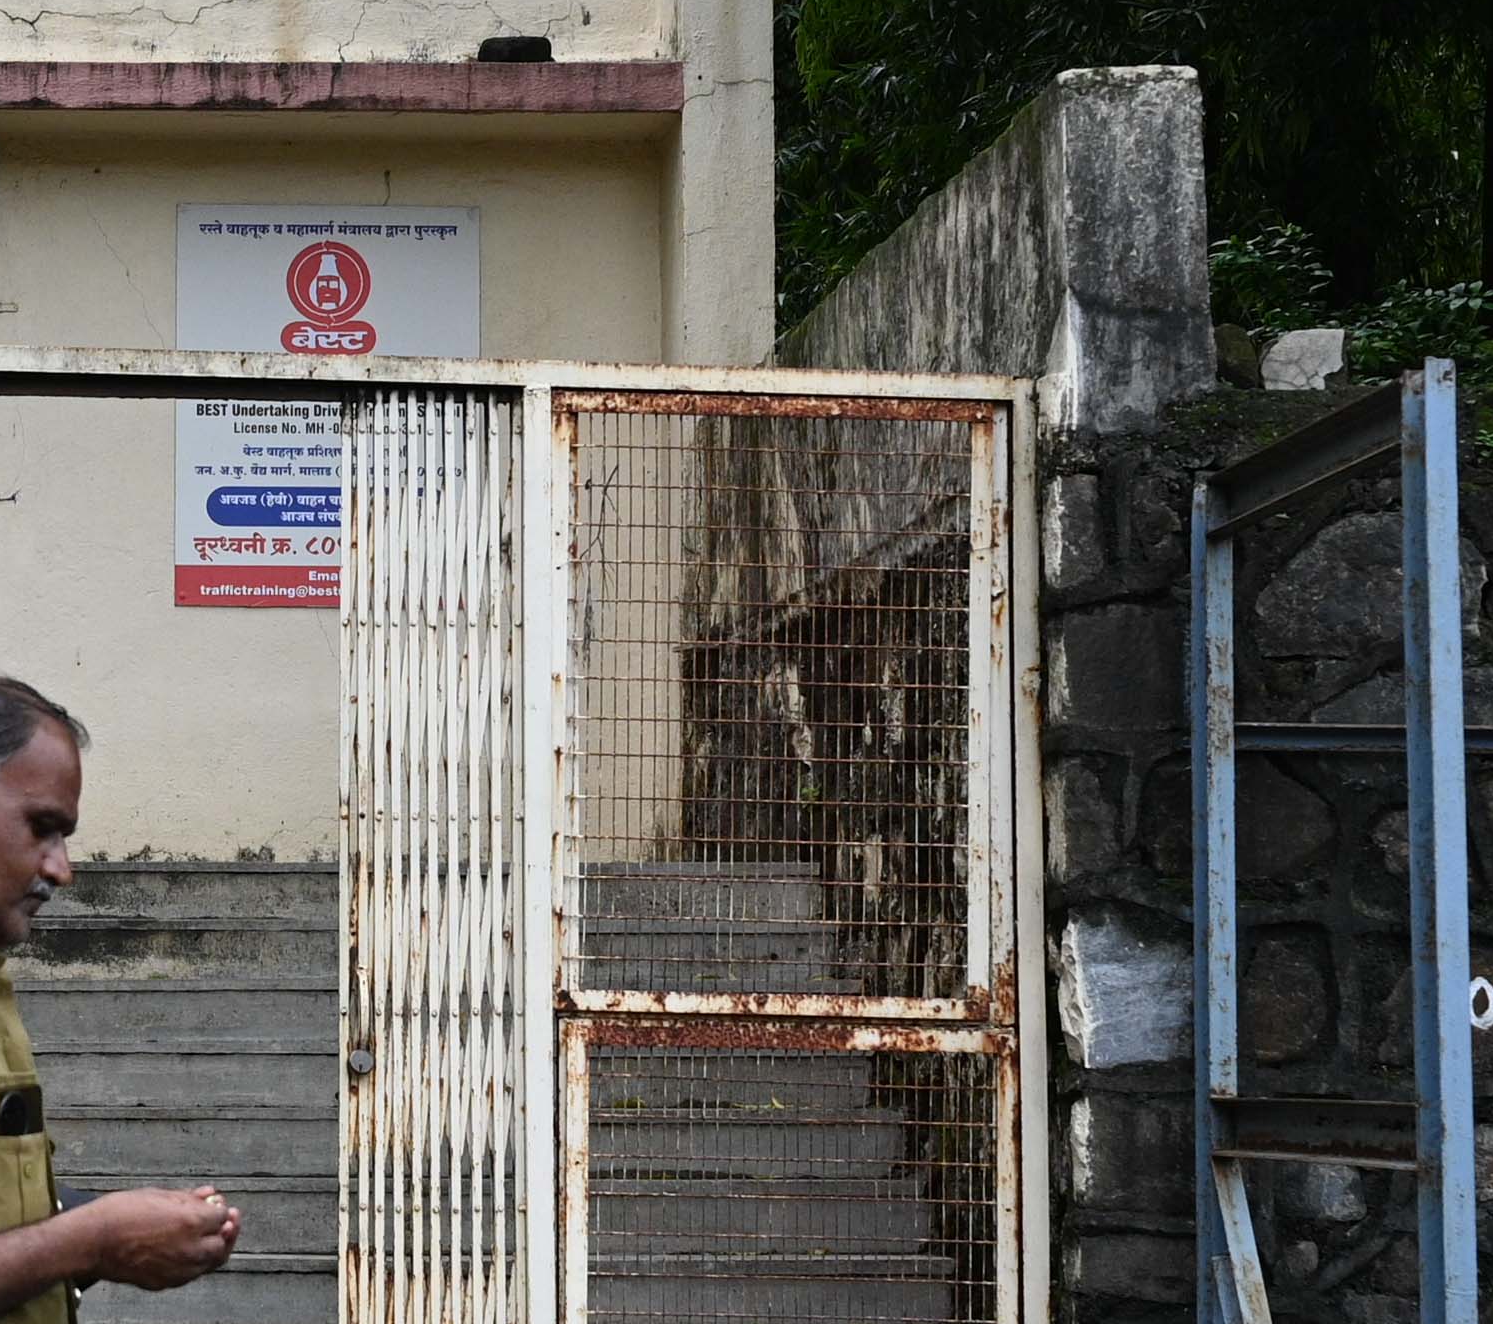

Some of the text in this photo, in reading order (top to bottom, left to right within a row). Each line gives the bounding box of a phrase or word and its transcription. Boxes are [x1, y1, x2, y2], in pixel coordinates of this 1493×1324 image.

[291, 326, 367, 350] बेस्ट
[196, 403, 228, 417] BEST
[232, 403, 310, 419] Undertaking
[234, 422, 278, 434] License
[281, 422, 301, 434] No.
[305, 423, 325, 434] MH
[193, 531, 267, 562] दूरध्वनी
